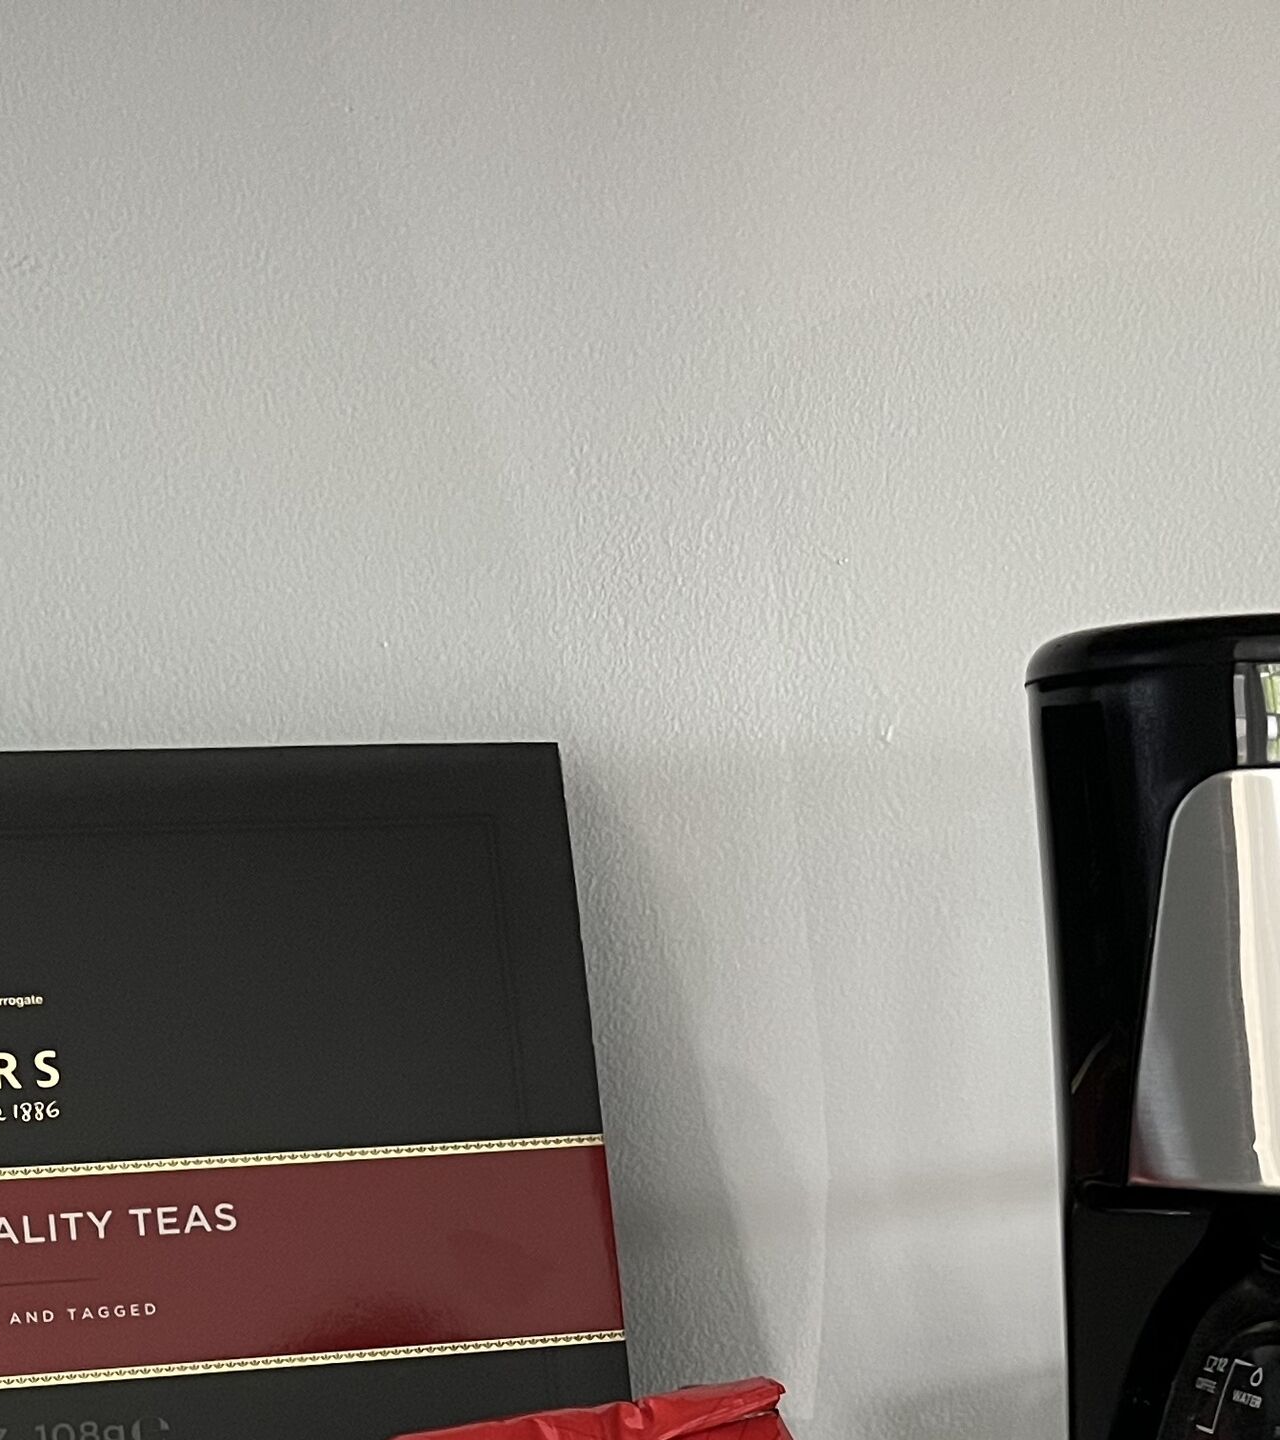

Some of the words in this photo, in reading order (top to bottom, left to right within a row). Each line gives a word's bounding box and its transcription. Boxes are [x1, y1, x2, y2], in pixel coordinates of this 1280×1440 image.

[12, 1100, 61, 1121] 1886
[128, 1202, 239, 1238] TEAS
[9, 1308, 55, 1326] AND
[66, 1302, 158, 1321] TAGGED
